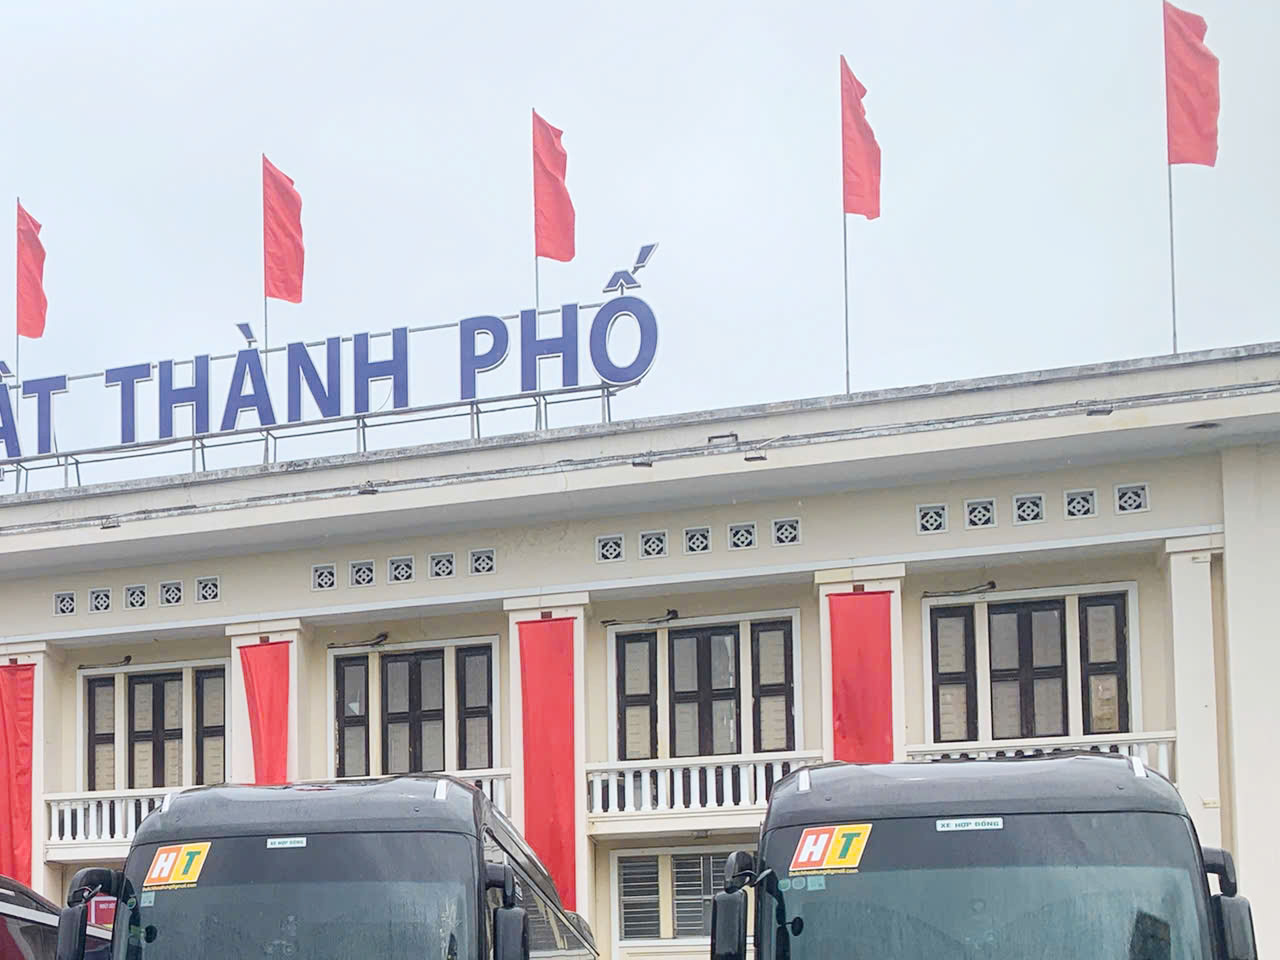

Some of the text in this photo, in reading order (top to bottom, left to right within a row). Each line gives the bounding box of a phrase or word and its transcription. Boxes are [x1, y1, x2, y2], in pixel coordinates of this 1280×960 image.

[105, 323, 409, 443] THÀNH
[459, 243, 659, 400] PHỐ
[940, 821, 951, 829] XE
[798, 832, 861, 863] HT
[151, 851, 201, 879] HT
